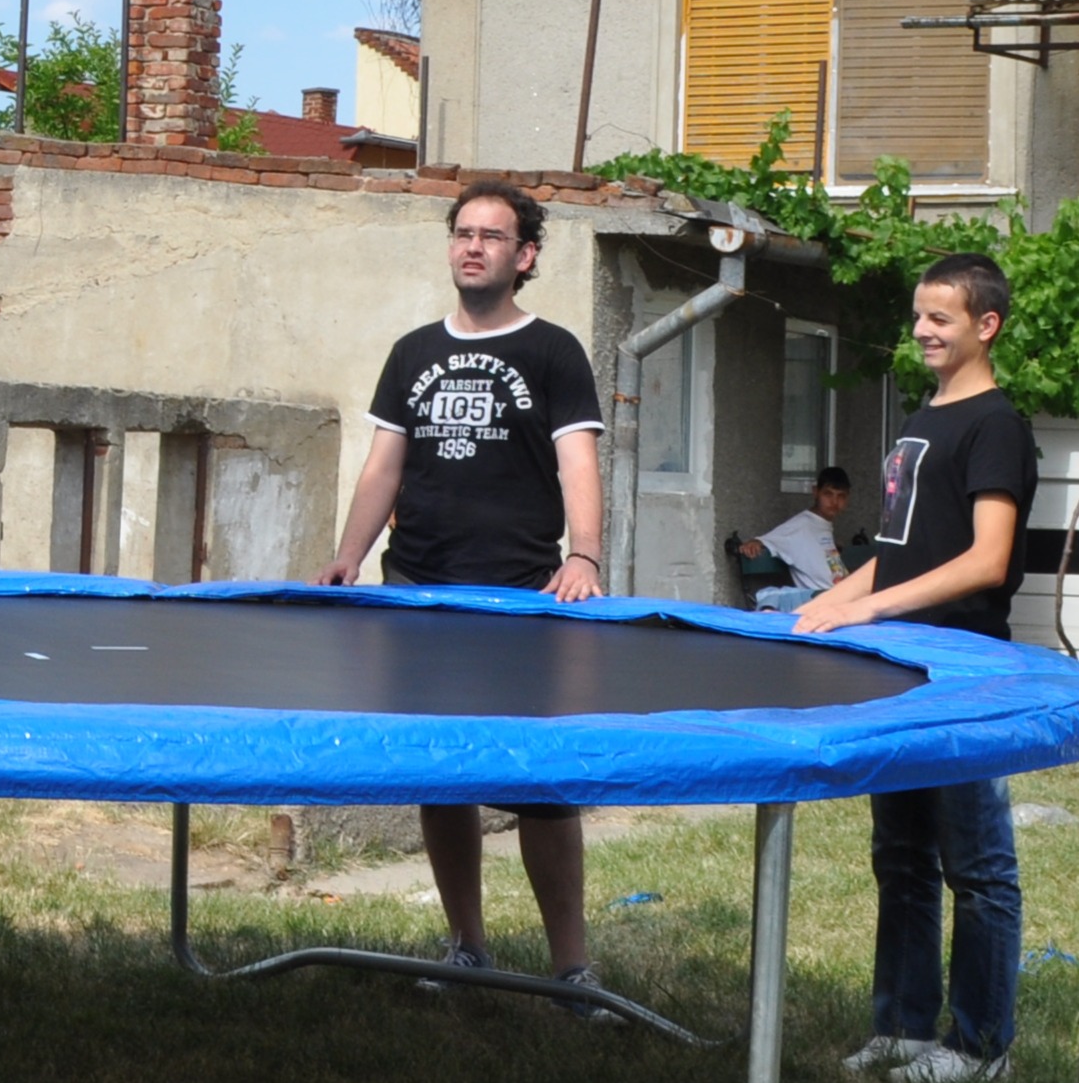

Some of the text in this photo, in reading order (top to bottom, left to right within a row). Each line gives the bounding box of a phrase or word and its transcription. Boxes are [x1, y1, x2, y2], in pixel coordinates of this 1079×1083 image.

[407, 352, 533, 410] AREA SIXTY-TWO
[440, 379, 494, 391] VARSITY
[417, 401, 431, 417] N
[494, 402, 507, 418] Y
[414, 425, 510, 440] ATHLETIC TEAM
[436, 438, 477, 460] 1956
